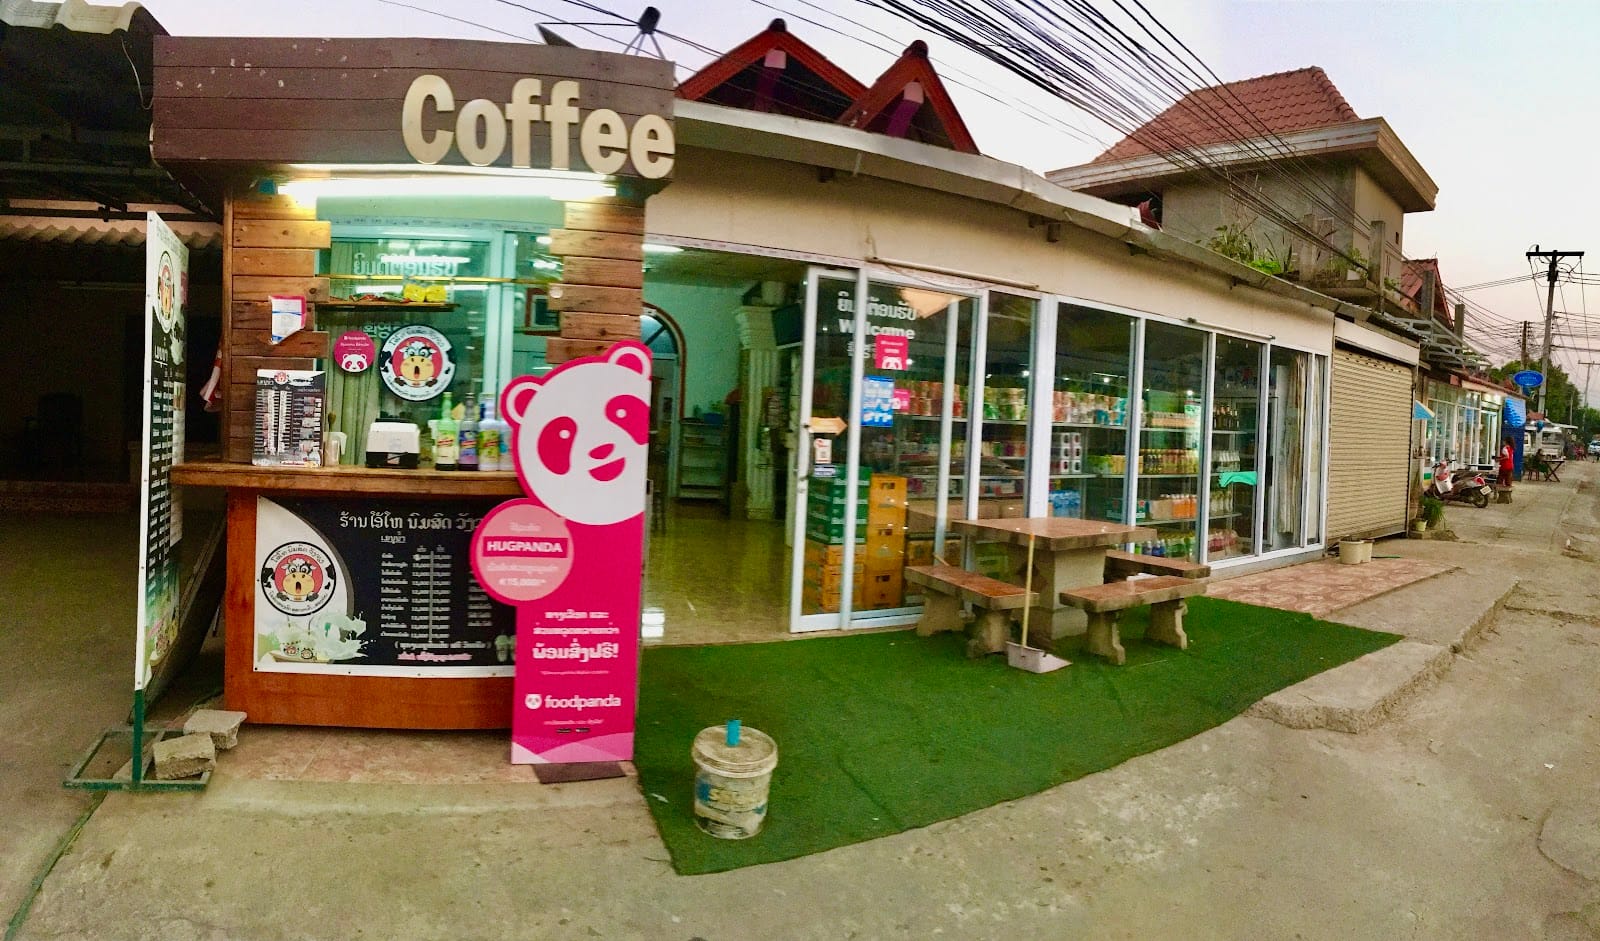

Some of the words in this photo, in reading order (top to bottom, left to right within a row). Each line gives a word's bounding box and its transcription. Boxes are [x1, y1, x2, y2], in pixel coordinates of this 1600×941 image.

[402, 74, 676, 180] Coffee
[838, 318, 915, 340] Wlcome
[486, 540, 563, 553] HUGPANDA
[544, 693, 622, 711] foodpanda
